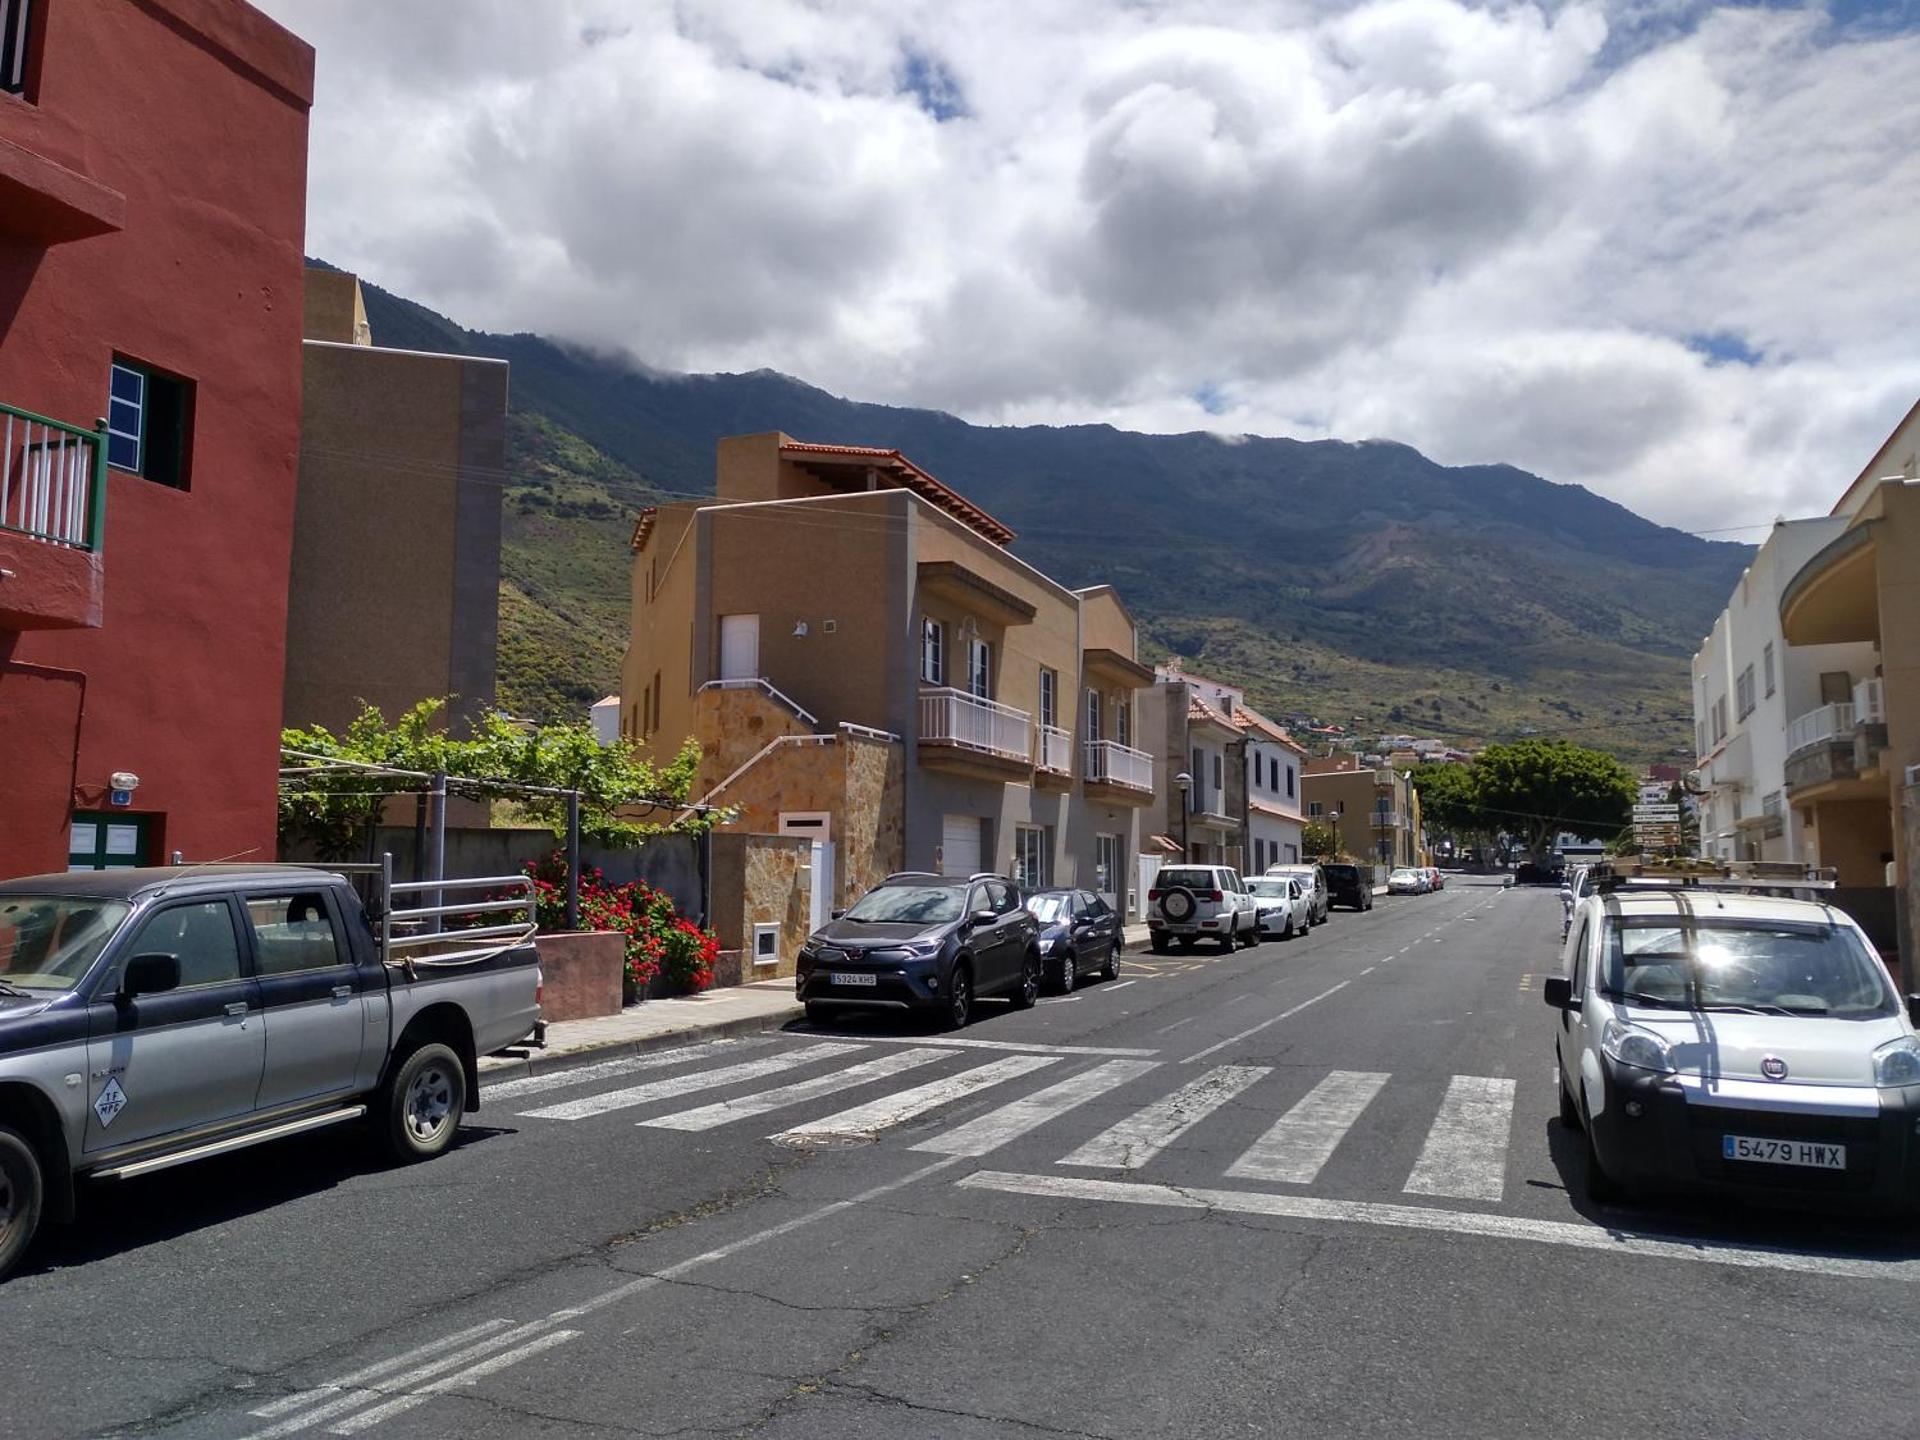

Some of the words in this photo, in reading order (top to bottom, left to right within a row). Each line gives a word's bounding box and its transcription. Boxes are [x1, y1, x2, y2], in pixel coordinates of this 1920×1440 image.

[837, 974, 857, 984] 5324
[1739, 1140, 1792, 1161] 5479
[1800, 1145, 1840, 1166] HWX
